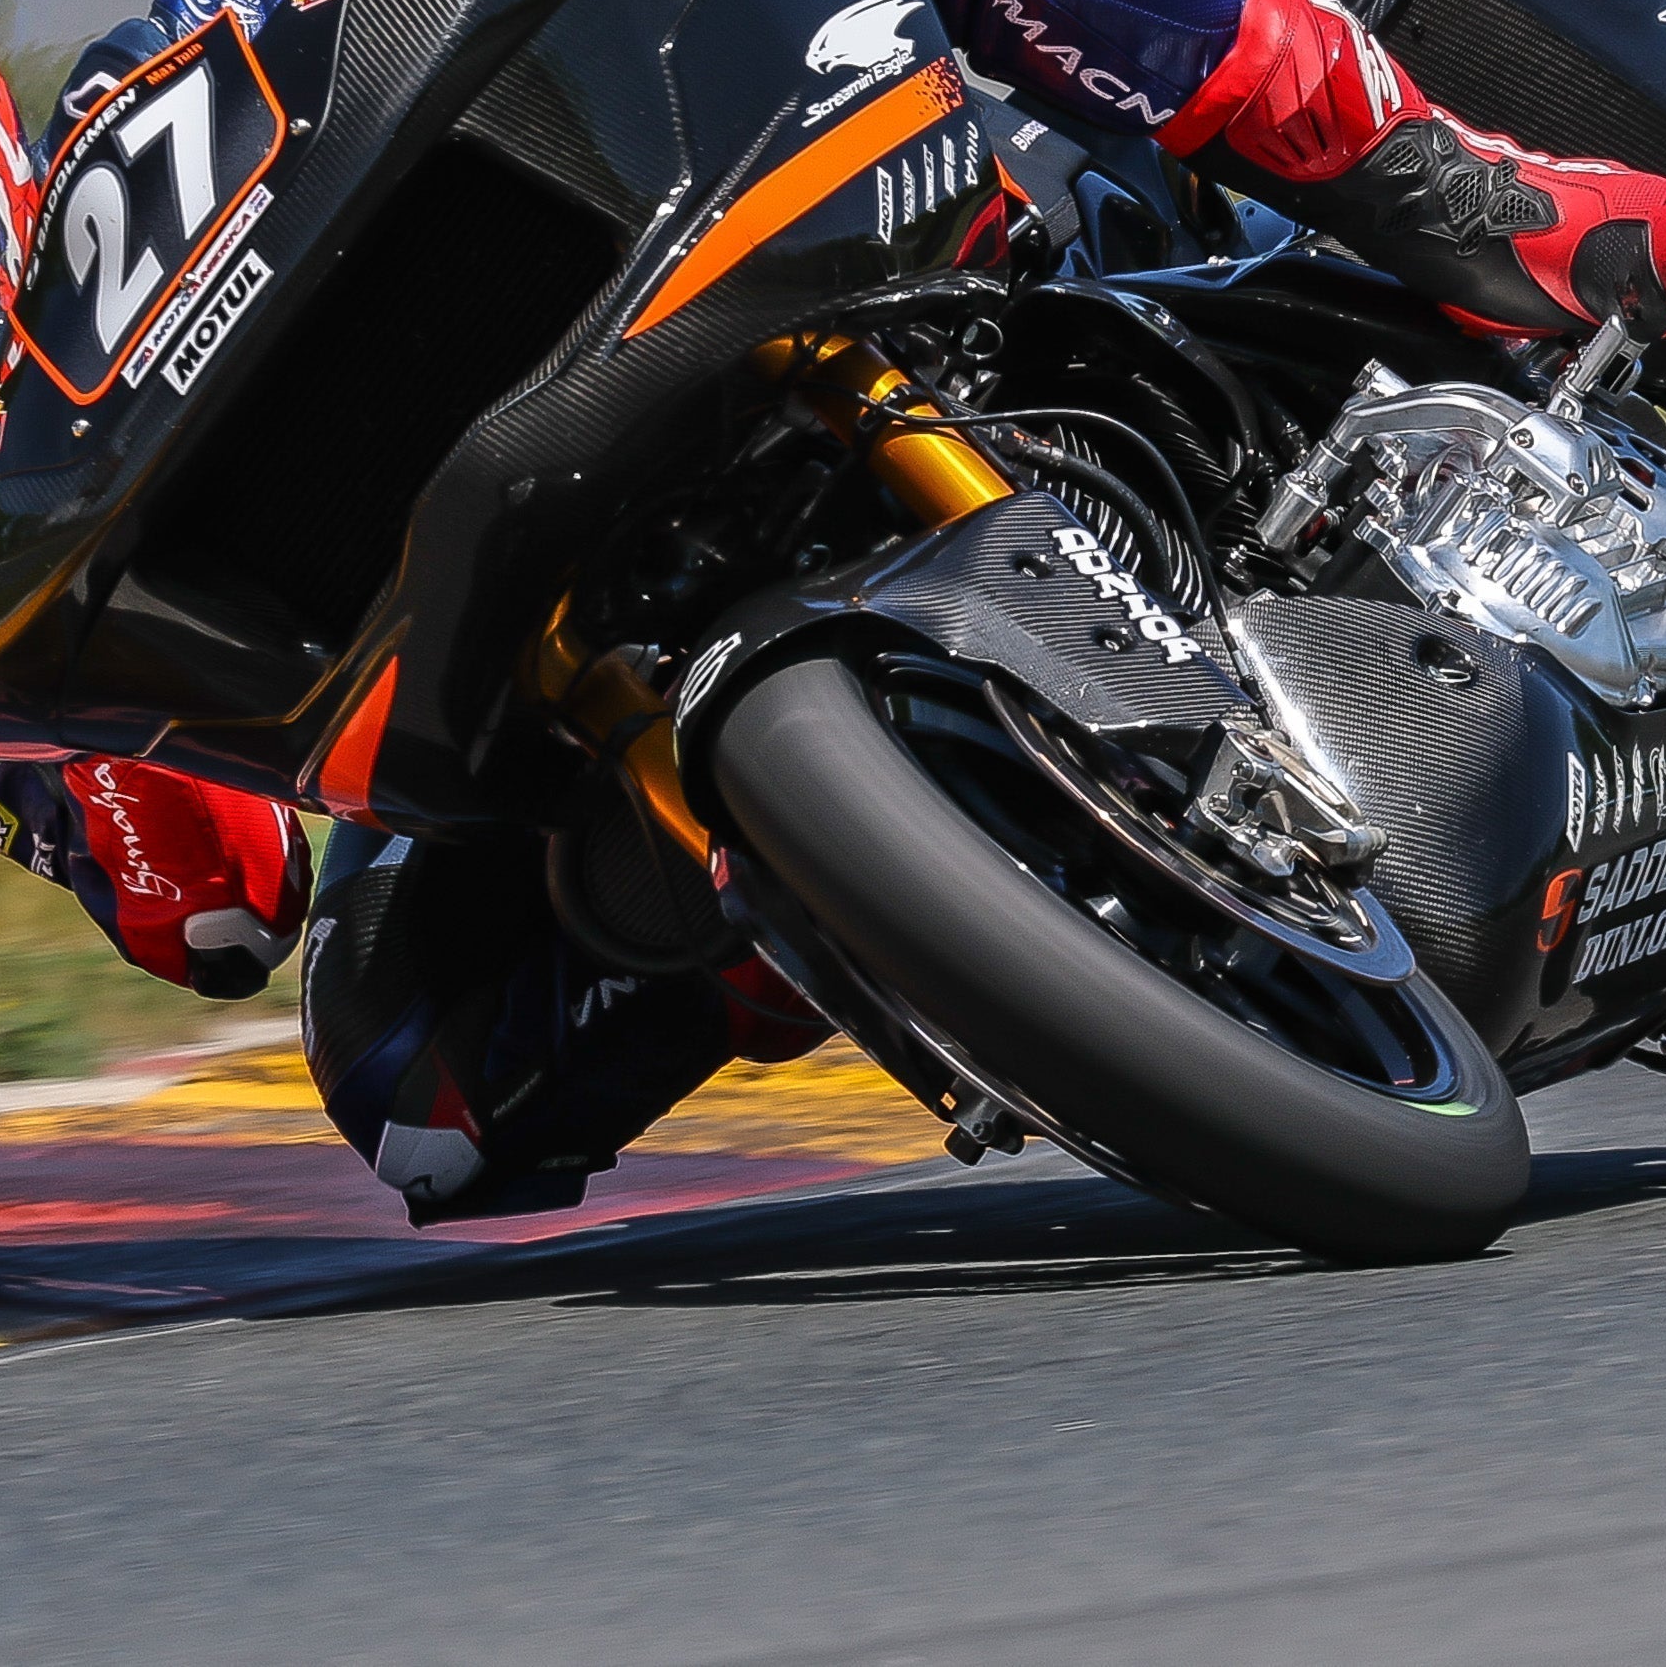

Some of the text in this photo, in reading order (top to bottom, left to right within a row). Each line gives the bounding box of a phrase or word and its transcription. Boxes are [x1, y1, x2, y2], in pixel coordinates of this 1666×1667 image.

[872, 49, 916, 82] Eagle
[63, 65, 217, 355] 27
[171, 261, 265, 384] MOTUL
[1051, 526, 1203, 665] DUNLOP
